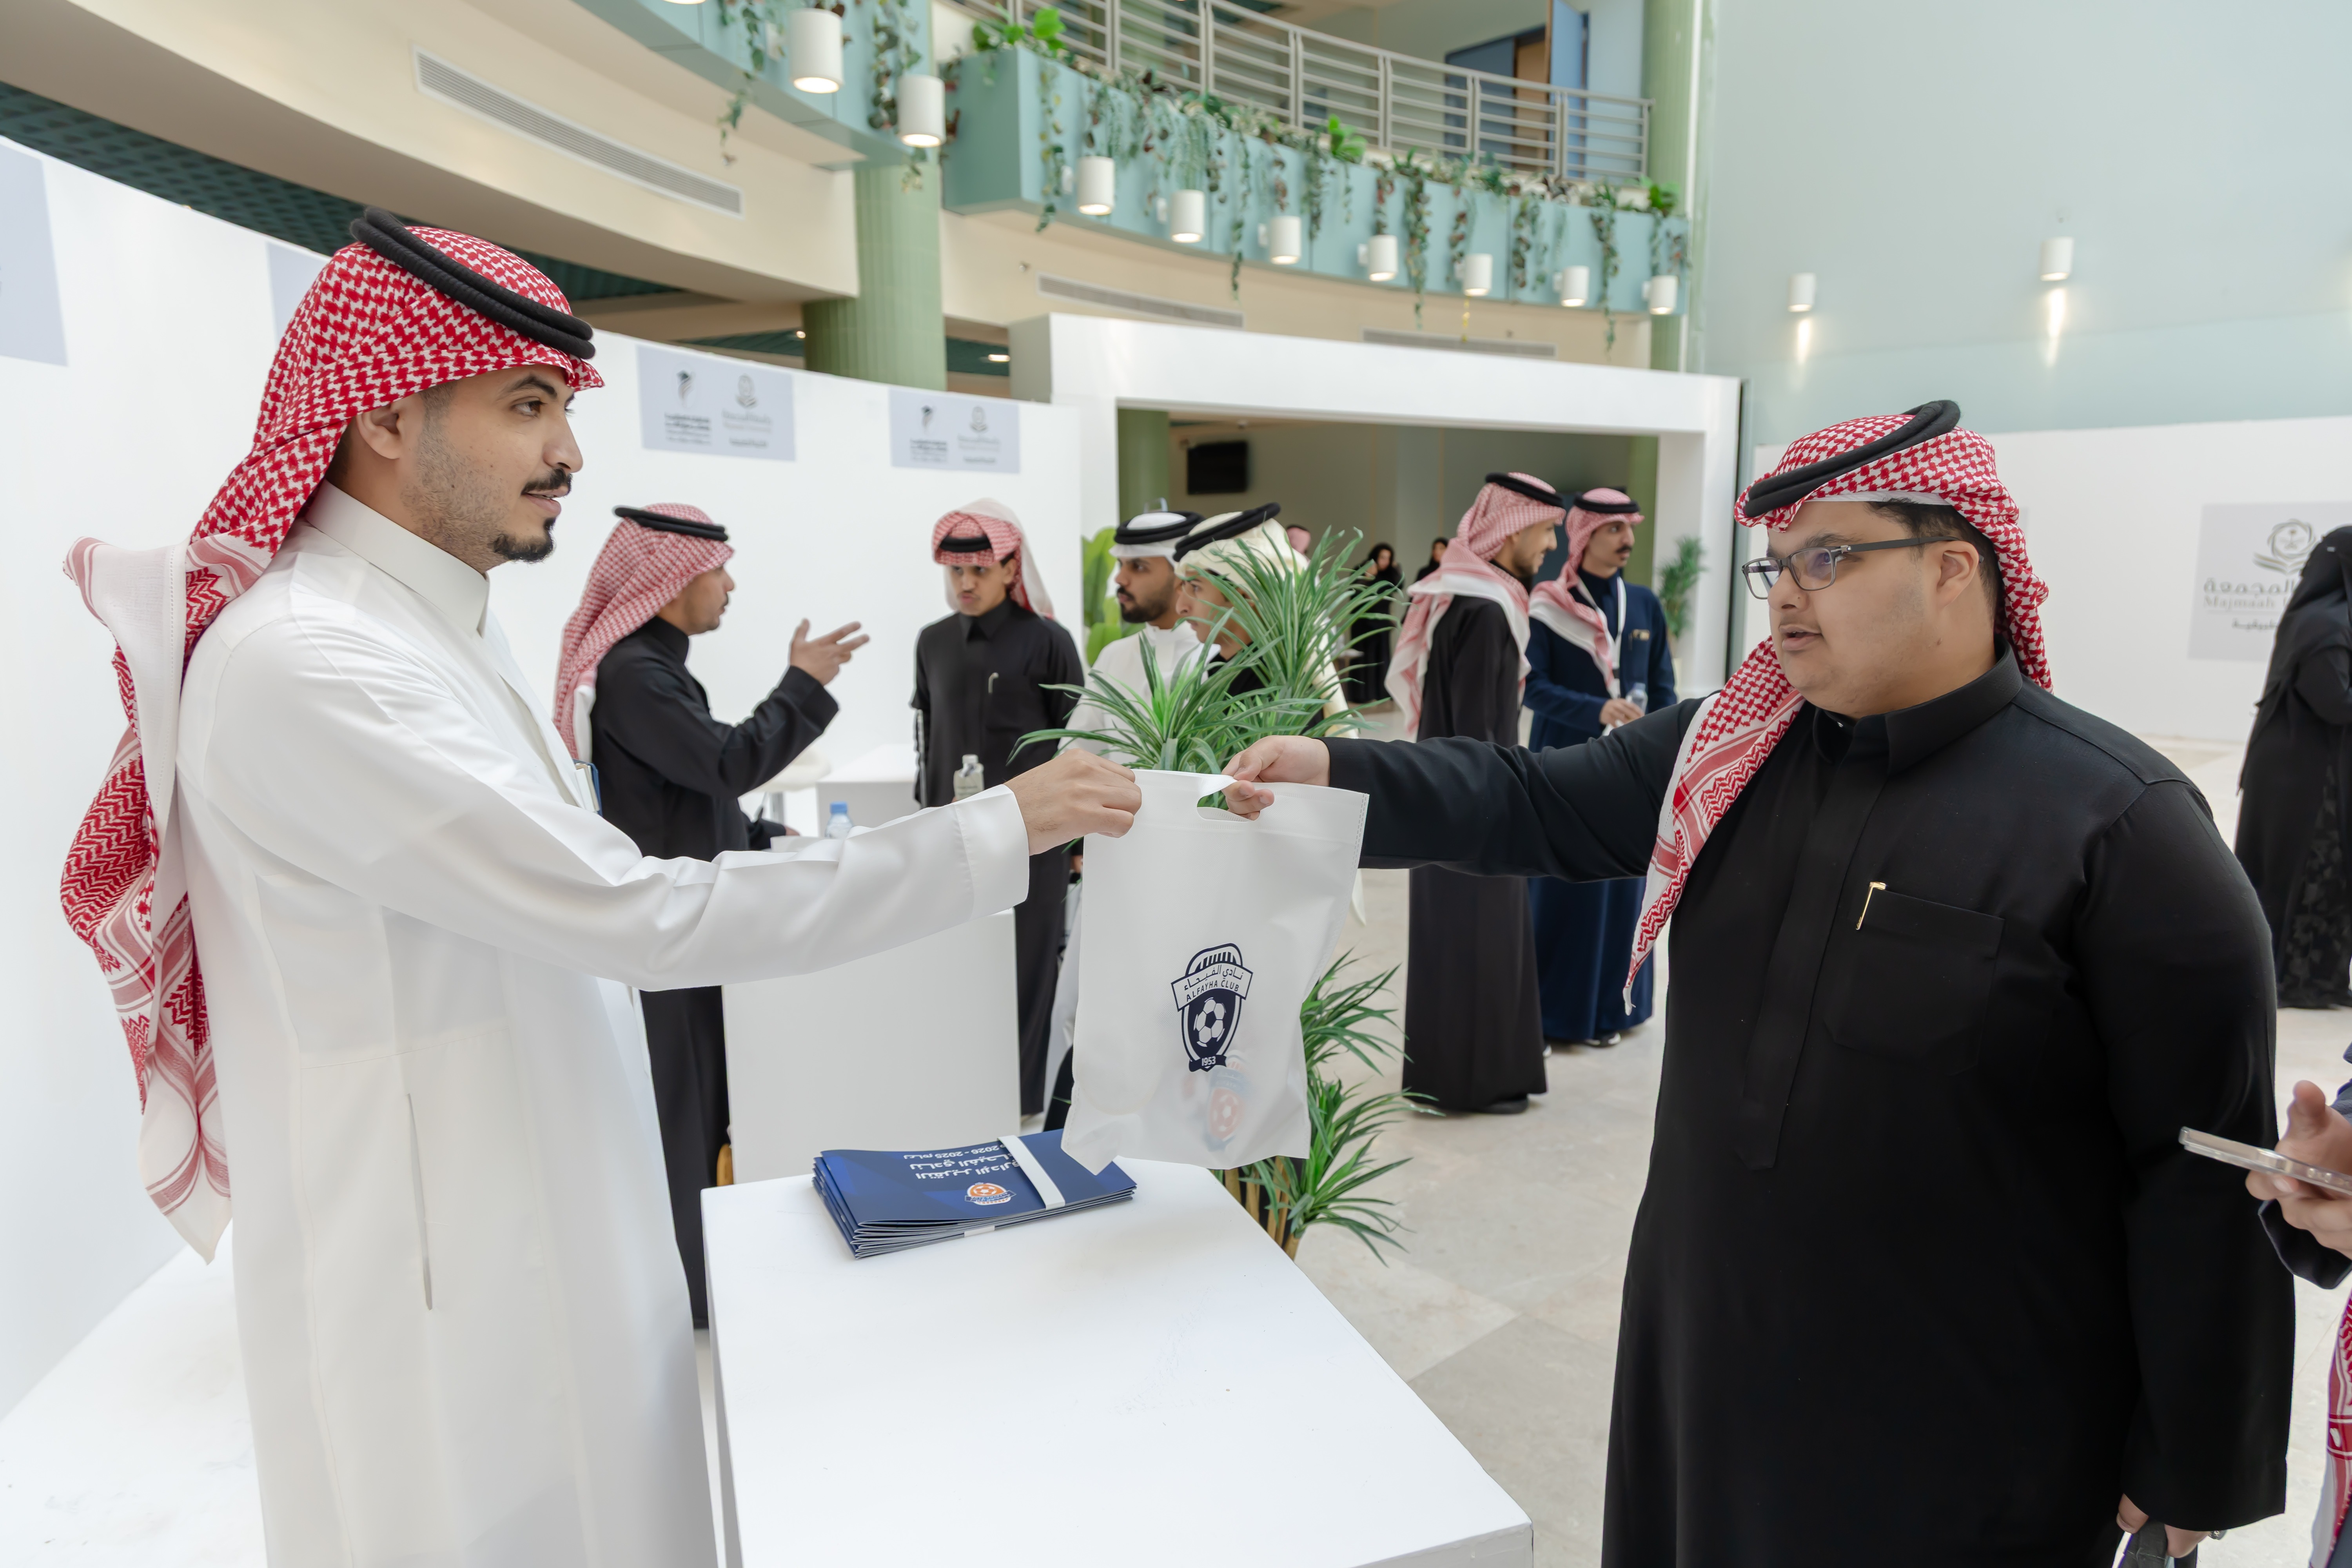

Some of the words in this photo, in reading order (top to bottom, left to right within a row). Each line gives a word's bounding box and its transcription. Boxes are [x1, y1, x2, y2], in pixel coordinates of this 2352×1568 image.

[1184, 964, 1222, 991] الفيحاء
[1223, 967, 1244, 980] نادي
[1186, 980, 1218, 1002] ALFAYHA
[1221, 980, 1239, 992] CLUB
[1201, 1056, 1216, 1066] 1953
[971, 1145, 999, 1154] 2026
[909, 1159, 956, 1170] لنادي
[915, 1168, 972, 1179] التقرير
